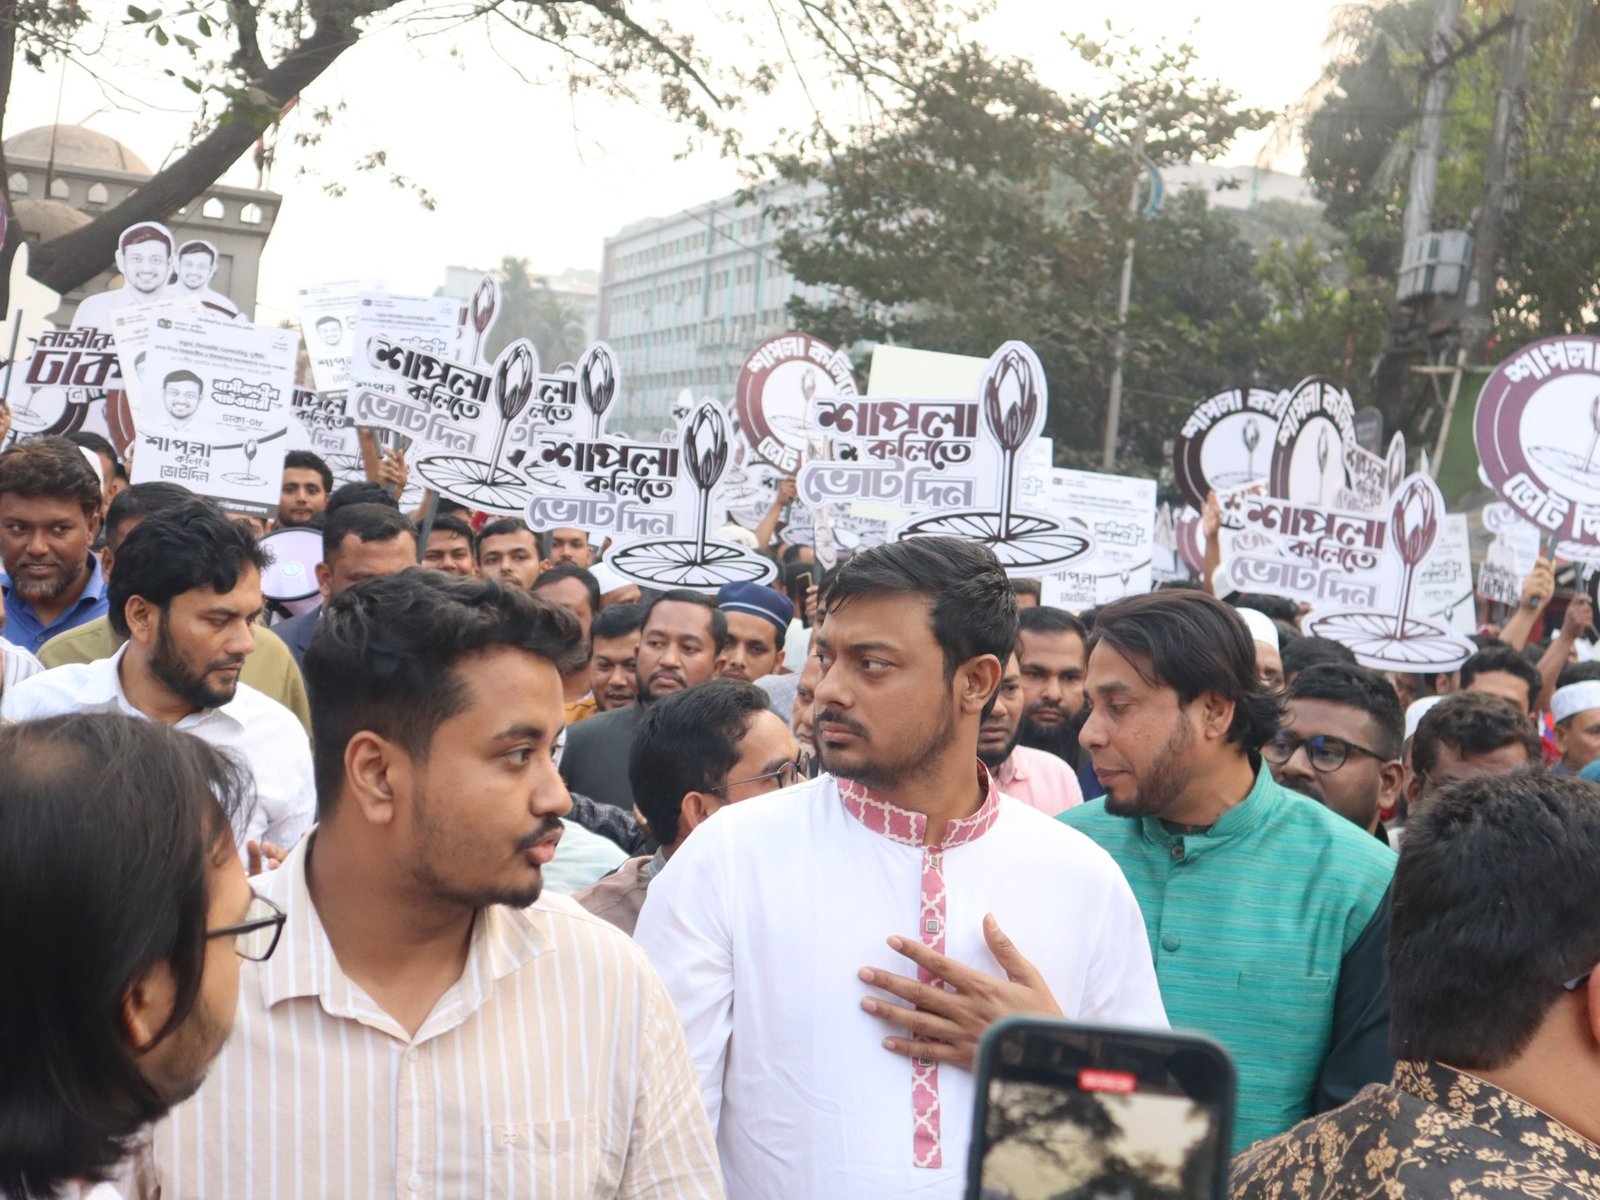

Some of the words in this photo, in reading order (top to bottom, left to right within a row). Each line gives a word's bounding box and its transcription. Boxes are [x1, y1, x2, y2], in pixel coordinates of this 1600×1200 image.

[25, 350, 122, 386] ঢাক
[376, 340, 492, 403] শাপলা
[407, 381, 481, 421] কলিতে
[817, 402, 979, 438] শাপলা
[145, 435, 212, 458] শাপলা
[540, 440, 679, 478] শাপলা
[867, 431, 971, 470] কলিতে
[584, 469, 673, 504] কলিতে
[1247, 500, 1387, 549] শাপলা
[1288, 536, 1377, 573] কলিতে
